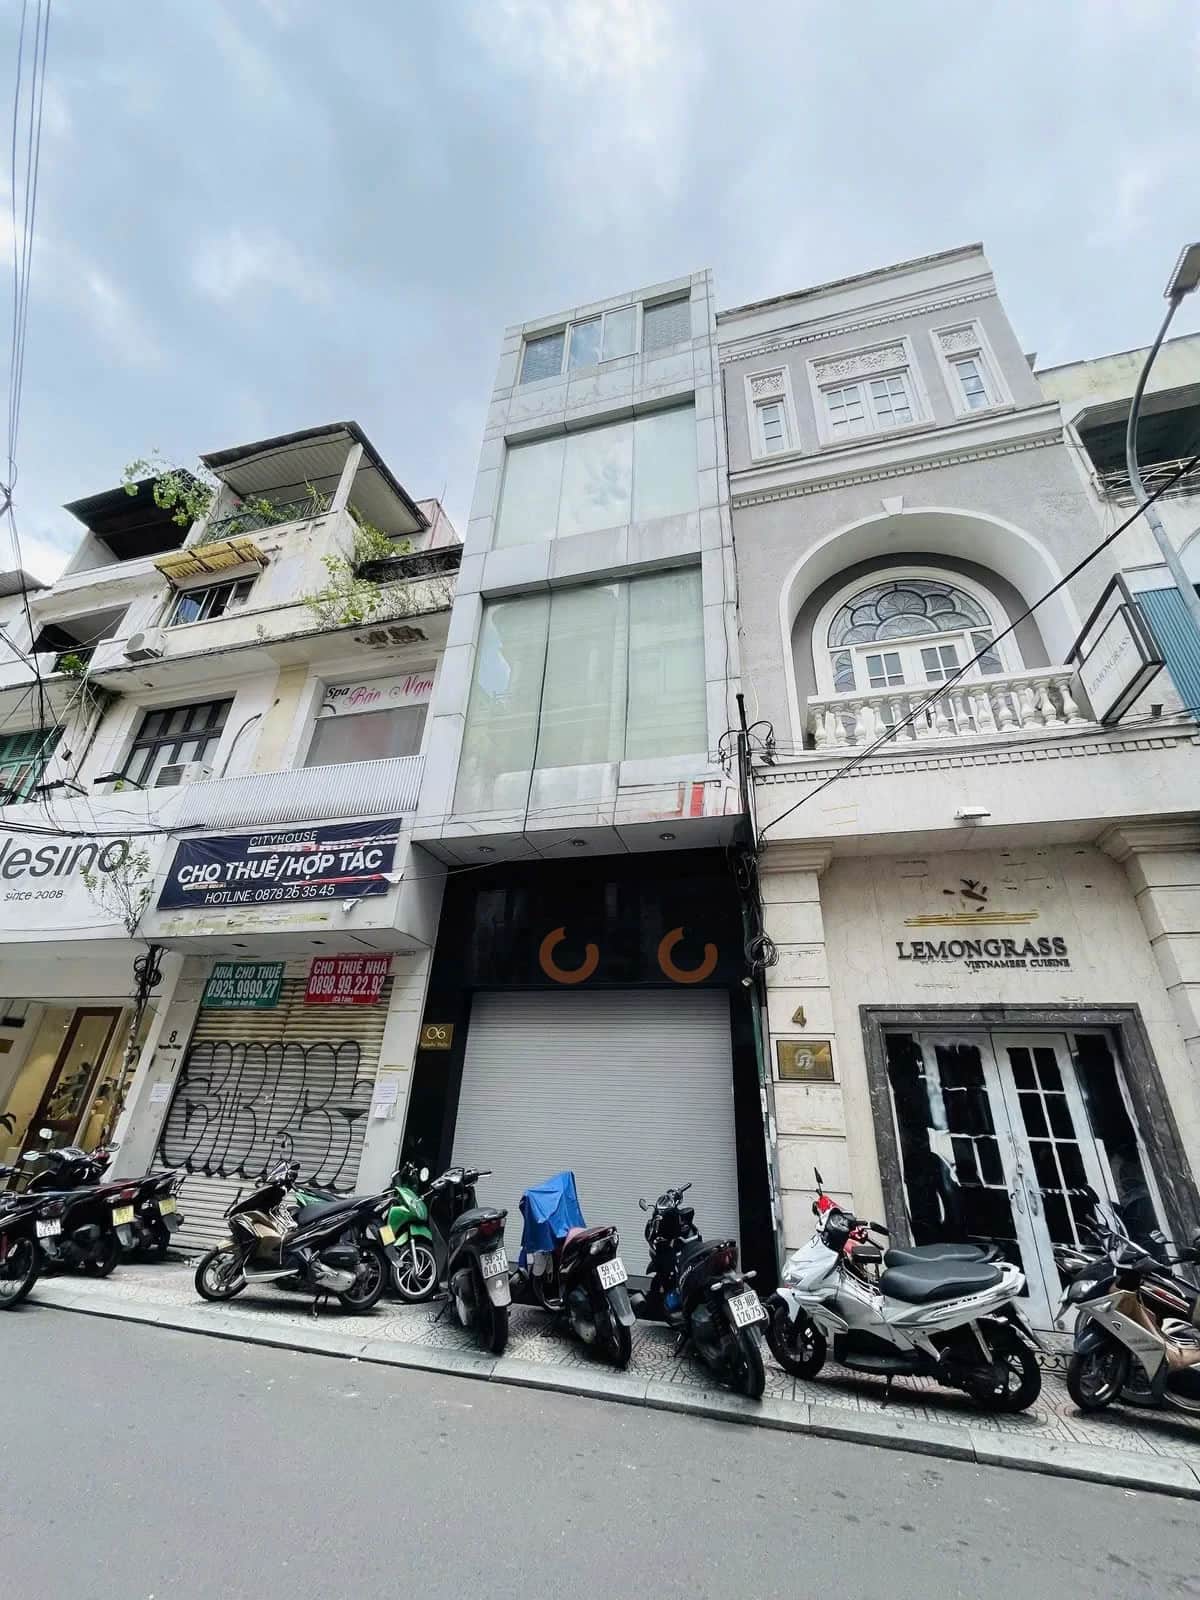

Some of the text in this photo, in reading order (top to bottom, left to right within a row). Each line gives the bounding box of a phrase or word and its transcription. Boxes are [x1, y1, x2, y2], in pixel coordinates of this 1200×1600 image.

[327, 687, 350, 699] Spa
[249, 830, 319, 846] CITYHOUSE
[177, 863, 222, 883] CHO
[339, 846, 383, 871] TÁC
[4, 888, 63, 901] since 2008
[204, 889, 254, 904] HOTLINE:
[255, 887, 283, 901] 0878
[301, 884, 318, 898] 35
[318, 883, 336, 897] 45
[895, 937, 1068, 961] LEMONGRASS
[313, 961, 335, 975] CHO
[336, 958, 364, 975] THUÊ
[964, 958, 1070, 969] VIETNAMESE CUISINE
[234, 966, 256, 979] CHO
[792, 1005, 807, 1027] 4
[168, 1030, 178, 1043] 8
[426, 1026, 446, 1040] 06
